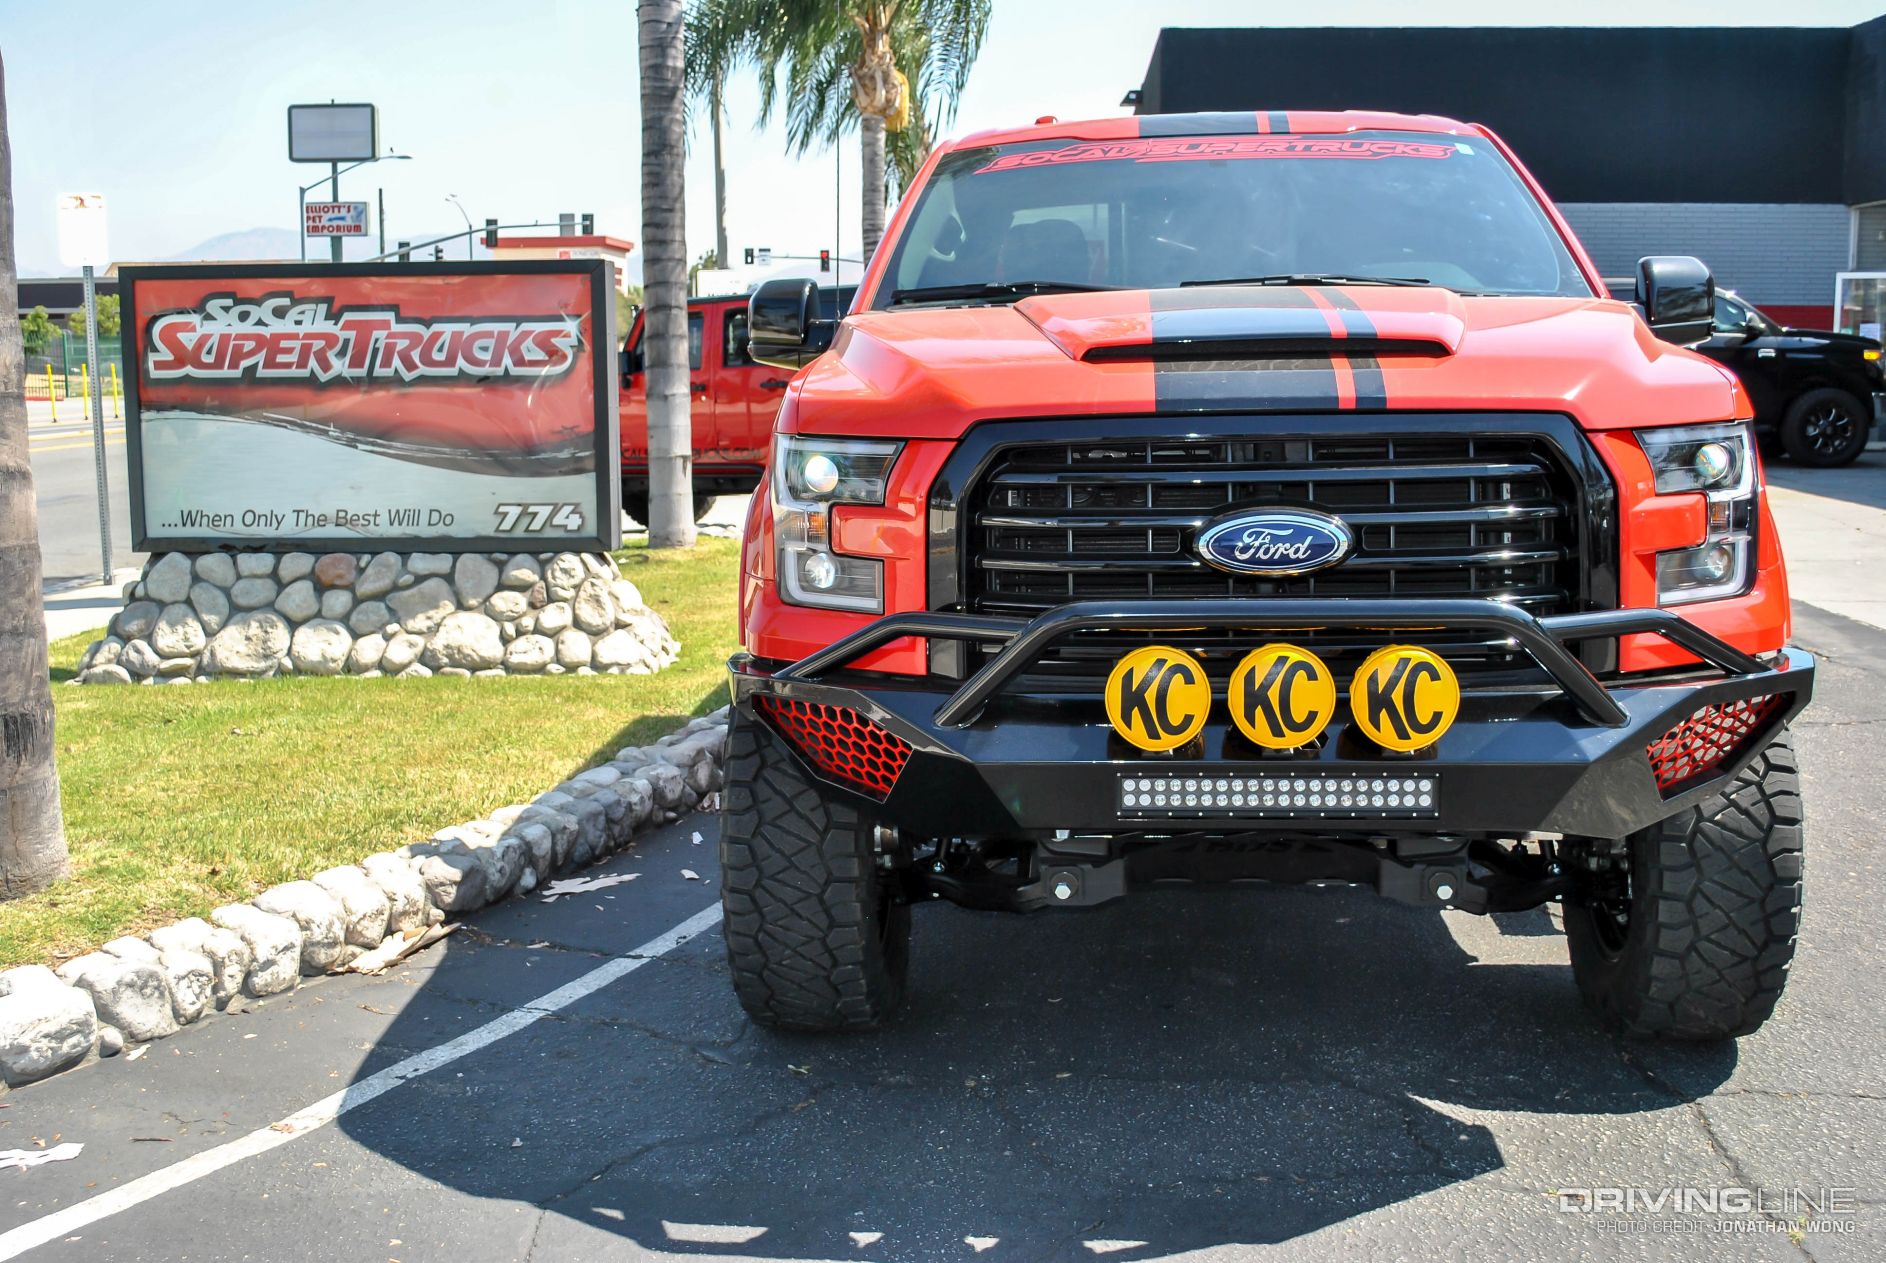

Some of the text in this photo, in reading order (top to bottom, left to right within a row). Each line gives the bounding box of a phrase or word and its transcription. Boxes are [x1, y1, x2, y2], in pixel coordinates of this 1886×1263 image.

[989, 141, 1450, 170] SOCAL SUPERTRUCKS
[305, 205, 352, 214] ELLIOTT'S
[306, 215, 323, 224] PET
[306, 224, 362, 233] EMPORIUM
[241, 509, 286, 531] Only
[292, 509, 328, 528] The
[335, 509, 381, 528] Best
[388, 508, 421, 527] Will
[427, 508, 455, 528] Do
[493, 502, 585, 534] 774
[1234, 527, 1312, 562] Ford
[1120, 657, 1196, 741] KC
[1243, 655, 1319, 738] KC
[1366, 657, 1444, 741] KC
